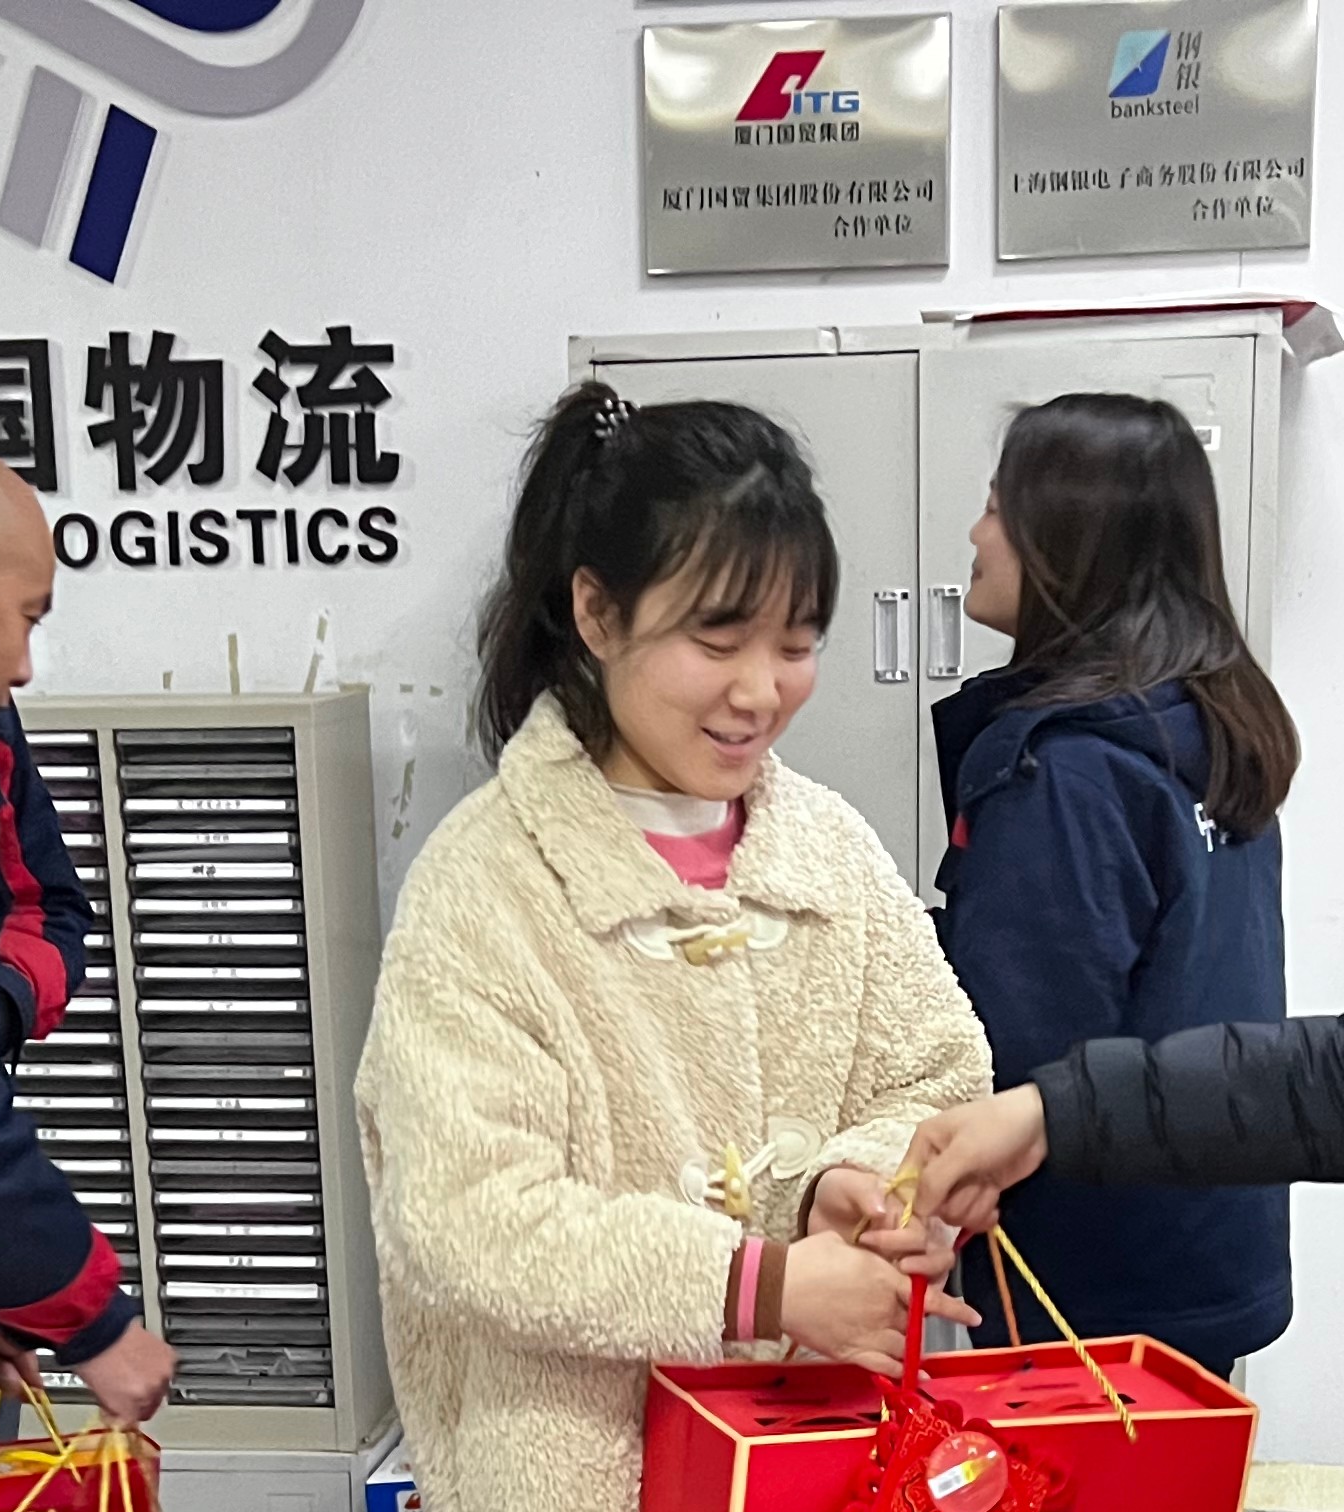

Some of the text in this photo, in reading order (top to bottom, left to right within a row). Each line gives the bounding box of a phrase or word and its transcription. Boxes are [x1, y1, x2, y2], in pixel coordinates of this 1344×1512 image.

[792, 90, 860, 116] ITG
[1111, 96, 1200, 120] banksteel
[734, 121, 860, 146] 厦门国贸集团
[1013, 157, 1306, 195] 上海钢银电子商务股份有限公司
[662, 179, 934, 212] 厦门国贸集团股份有限公司
[1192, 196, 1275, 221] 合作单位
[833, 214, 913, 238] 合作单位
[52, 505, 400, 570] OGISTICS
